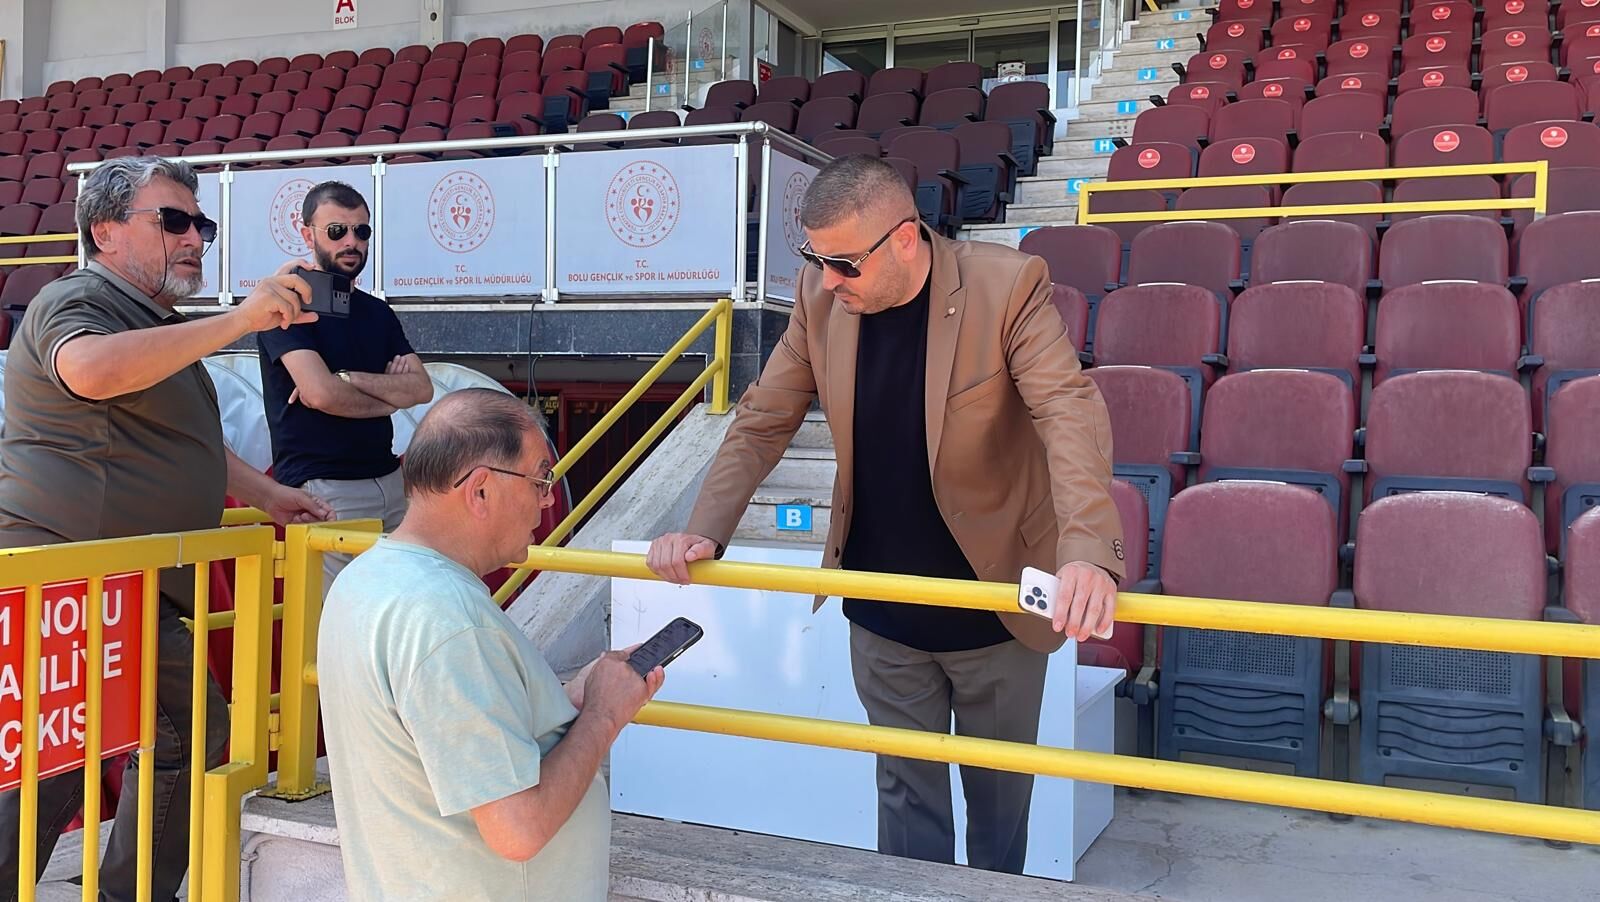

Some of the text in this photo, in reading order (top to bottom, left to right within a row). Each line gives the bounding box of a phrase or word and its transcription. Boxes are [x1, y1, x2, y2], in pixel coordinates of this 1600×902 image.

[336, 0, 355, 13] A
[335, 16, 355, 24] BLOK
[1178, 12, 1184, 21] L
[1160, 39, 1169, 49] K
[1143, 70, 1151, 80] J
[1100, 140, 1110, 151] H
[635, 259, 649, 269] T.C.
[394, 277, 413, 286] BOLU
[414, 275, 445, 287] GENÇLİK
[454, 276, 474, 285] SPOR
[569, 273, 588, 282] BOLU
[590, 271, 623, 283] GENÇLİK
[635, 272, 656, 281] SPOR
[239, 279, 256, 288] BOLU
[786, 508, 802, 527] B
[0, 701, 87, 772] ÇKIŞ
